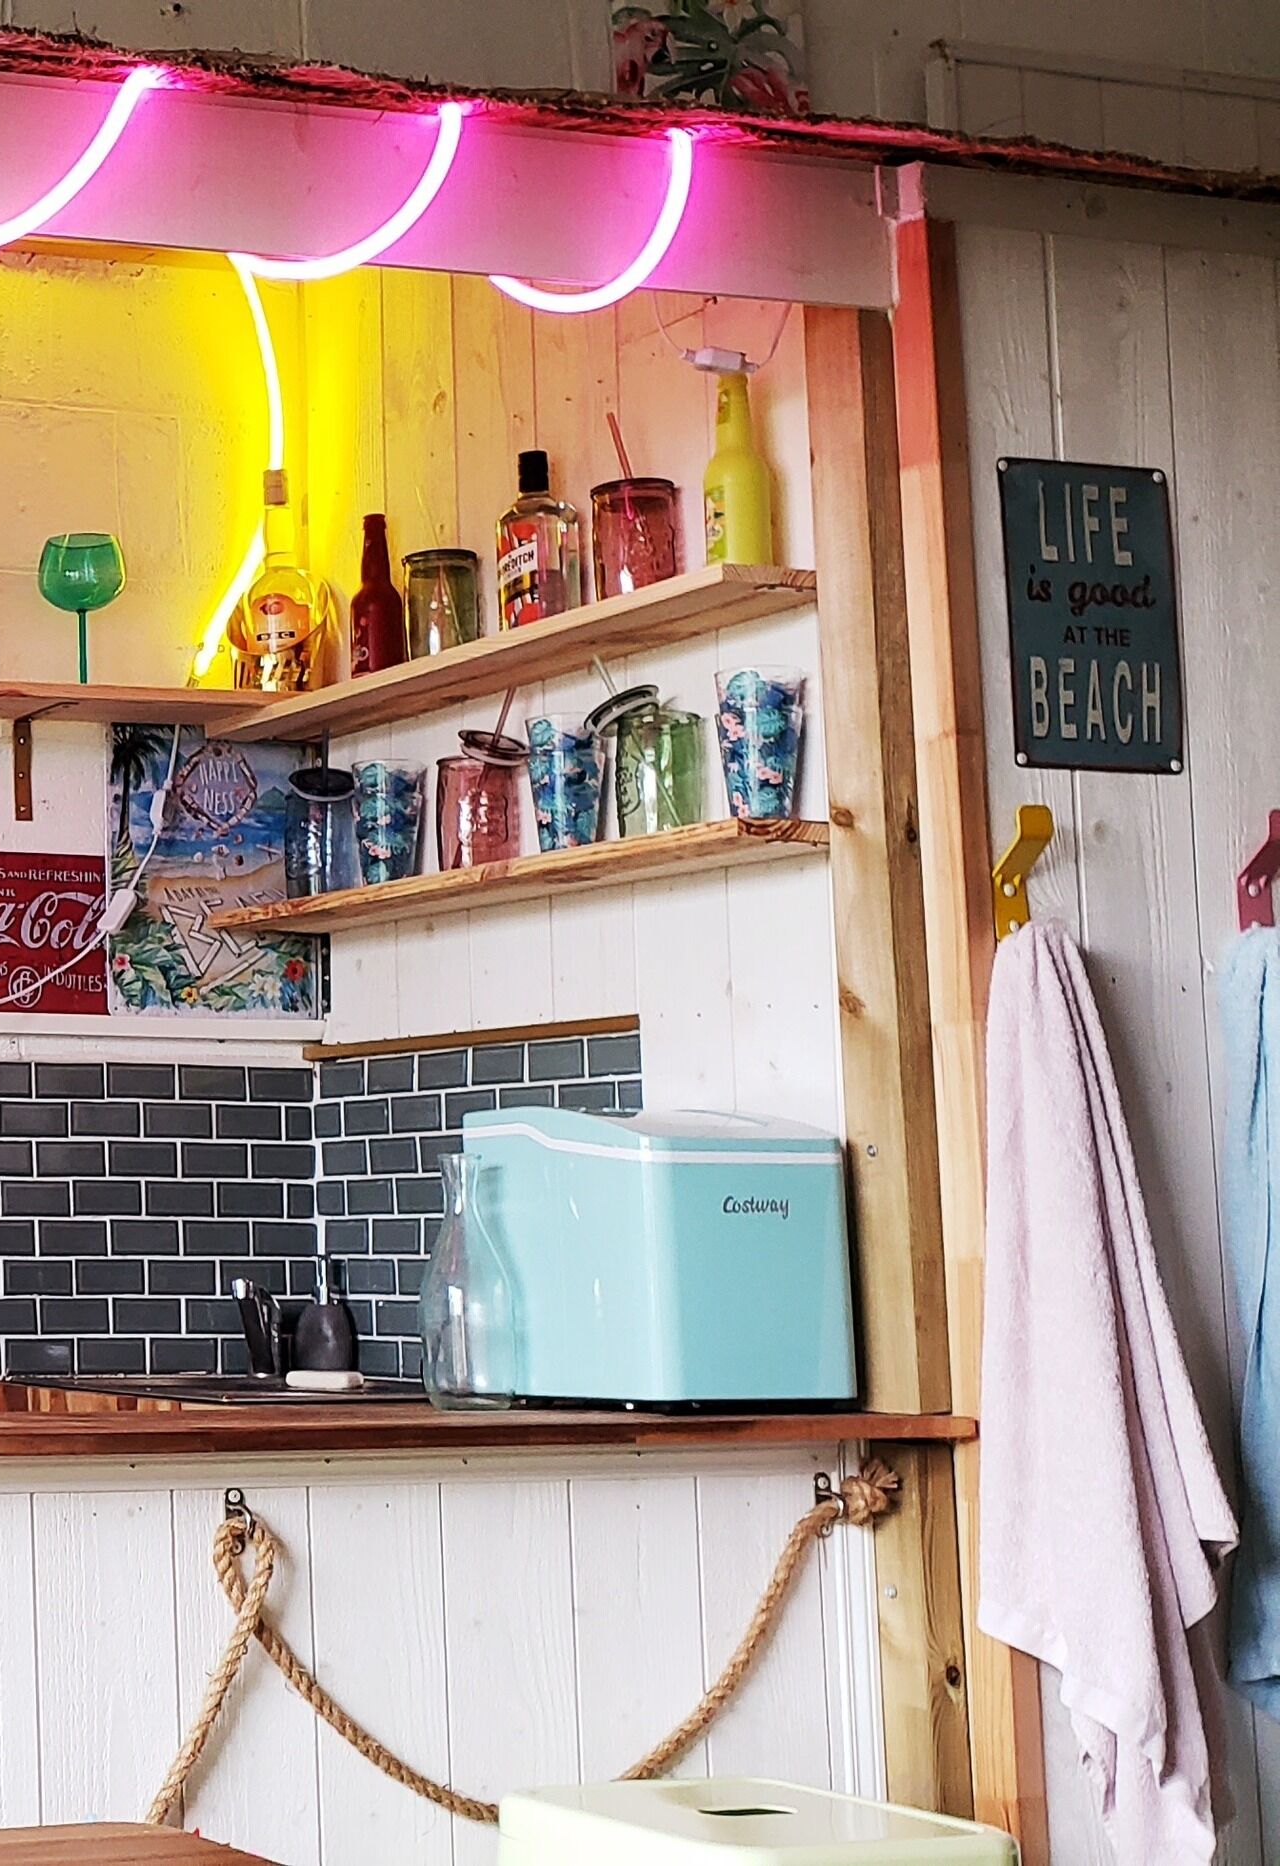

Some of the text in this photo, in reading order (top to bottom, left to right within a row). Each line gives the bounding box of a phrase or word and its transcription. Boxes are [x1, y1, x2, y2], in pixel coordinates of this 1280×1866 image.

[1038, 480, 1133, 566] LIFE
[1027, 564, 1156, 616] is good
[1063, 626, 1131, 647] AT THE
[1029, 656, 1162, 744] BEACH
[203, 788, 235, 816] NESS
[28, 869, 106, 883] REFRESHIN
[722, 1195, 790, 1220] Costway
